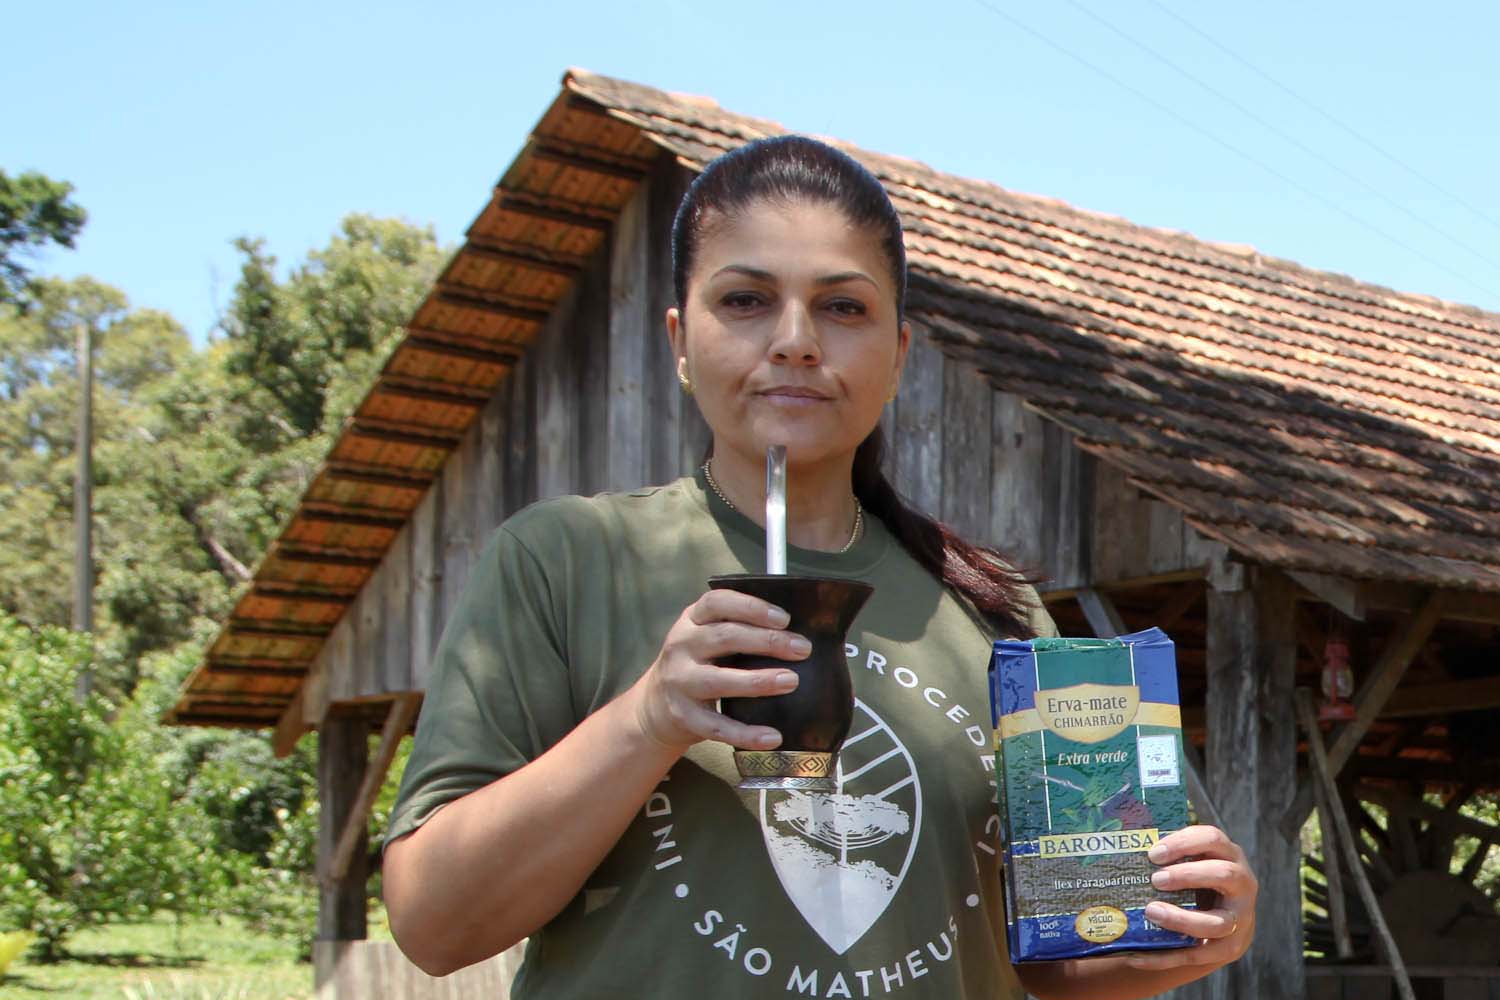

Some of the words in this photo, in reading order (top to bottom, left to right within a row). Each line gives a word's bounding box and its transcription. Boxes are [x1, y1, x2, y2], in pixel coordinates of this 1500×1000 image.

[1047, 695, 1128, 713] Erva-mate
[1054, 712, 1125, 729] CHIMARRÃO
[1057, 752, 1090, 766] Extra
[1095, 749, 1128, 764] verde
[1044, 832, 1155, 855] BARONESA
[694, 910, 773, 976] SÃO
[786, 915, 958, 998] MATHEUS
